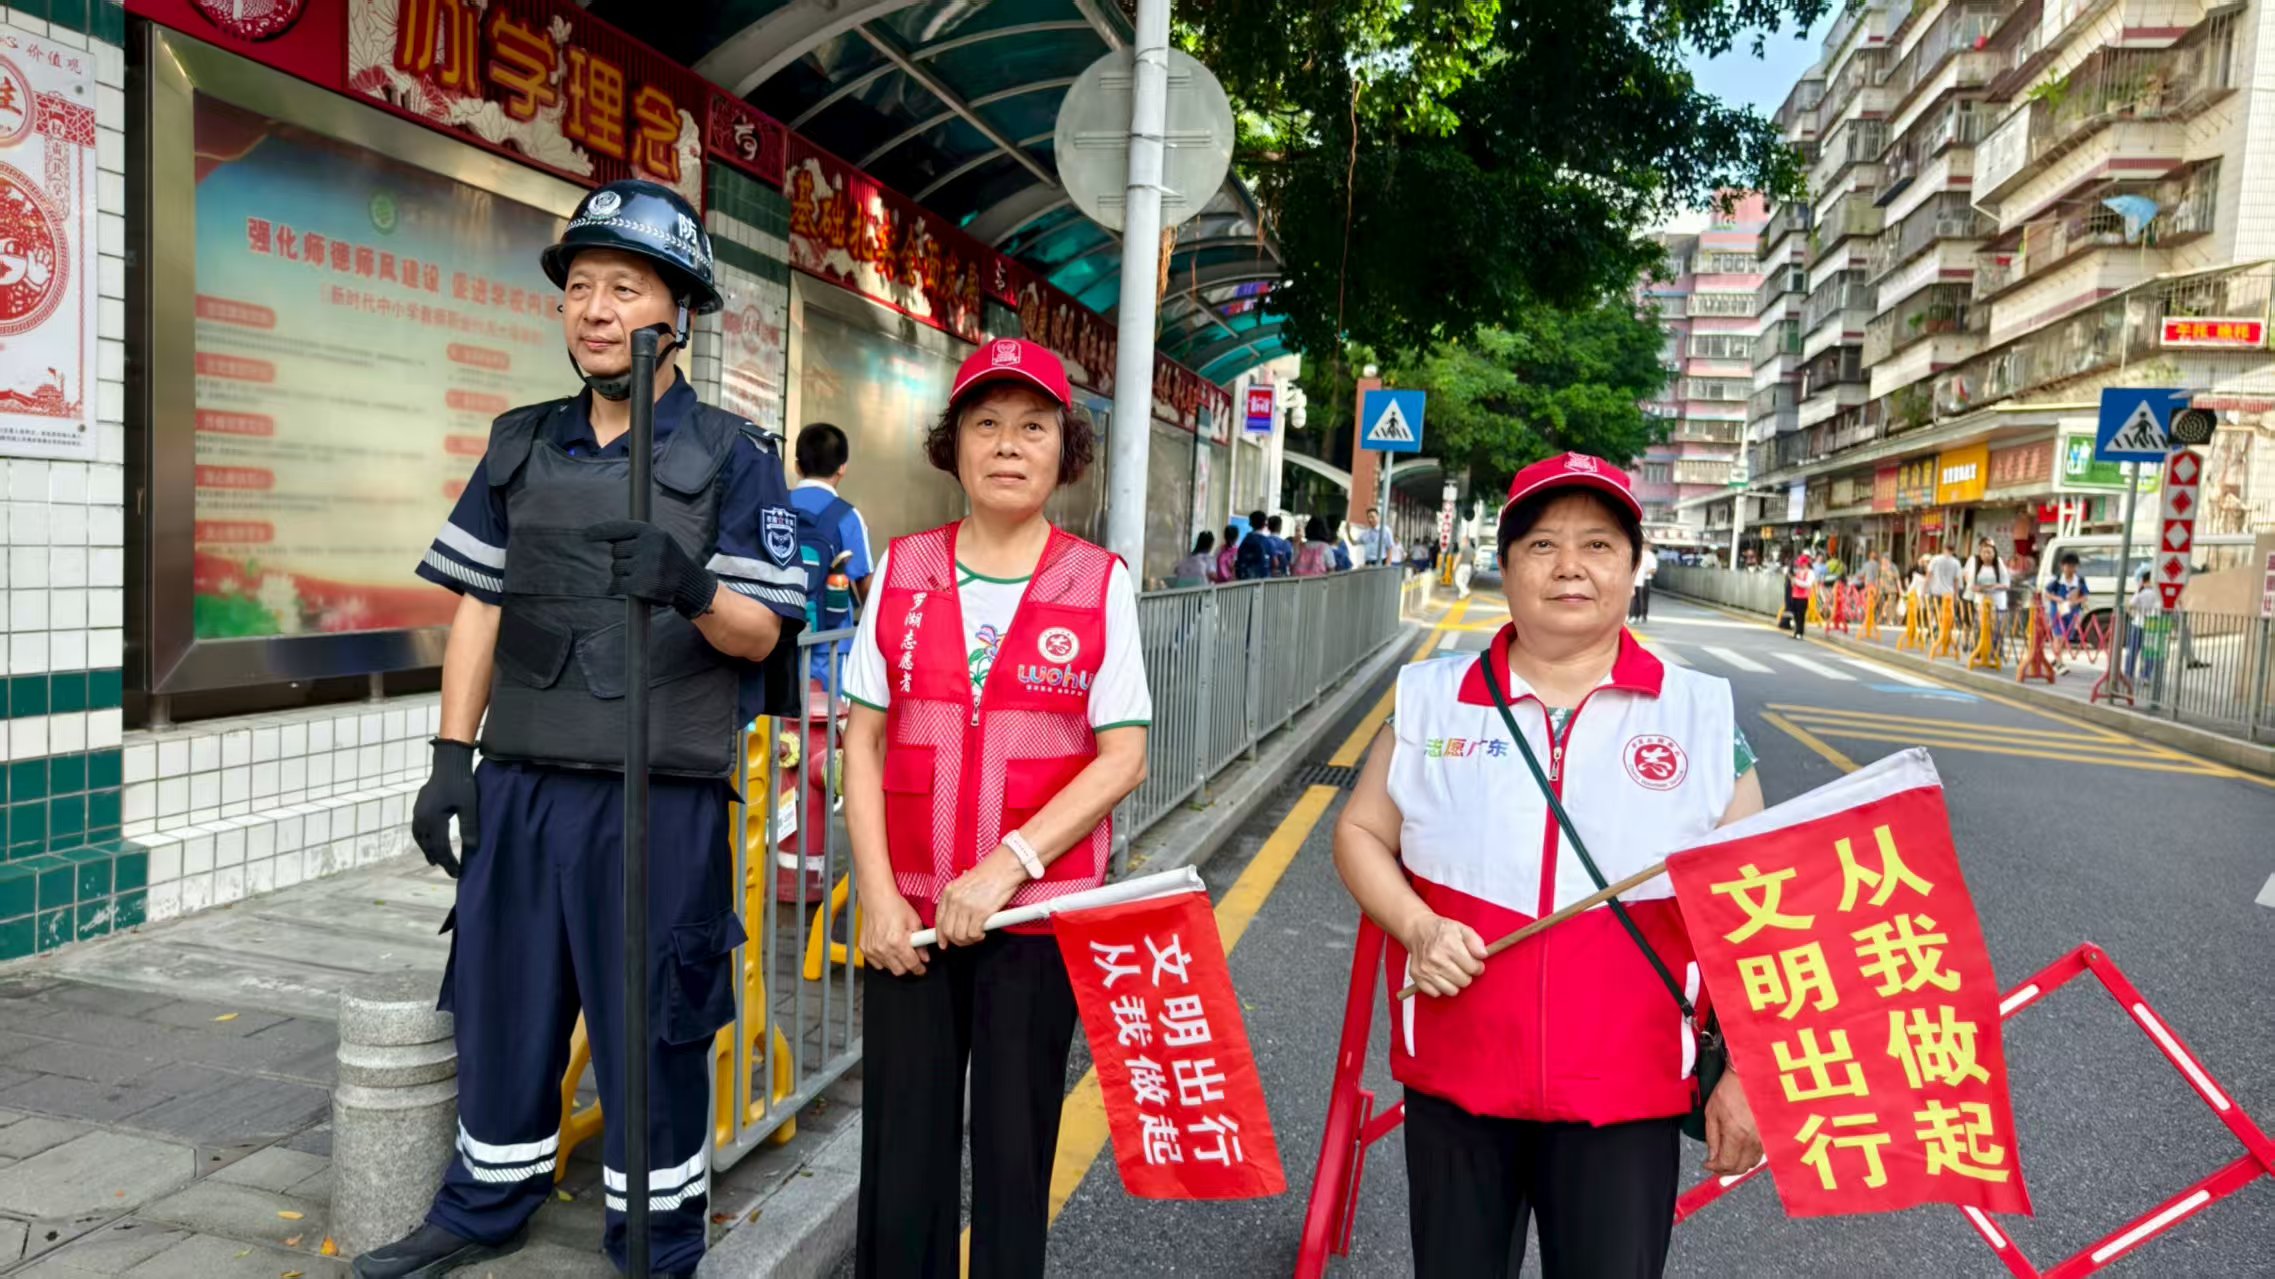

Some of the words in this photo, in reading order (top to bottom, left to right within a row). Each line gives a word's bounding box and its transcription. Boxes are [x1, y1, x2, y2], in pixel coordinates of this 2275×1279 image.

[247, 216, 440, 293] 强化师德师风建设
[898, 592, 928, 693] 罗湖志愿者
[1424, 738, 1510, 757] 志愿广东
[1090, 940, 1184, 1166] 从我做起
[1144, 933, 1244, 1167] 文明出行
[1711, 863, 1892, 1190] 文明出行
[1834, 824, 2010, 1183] 从我做起
